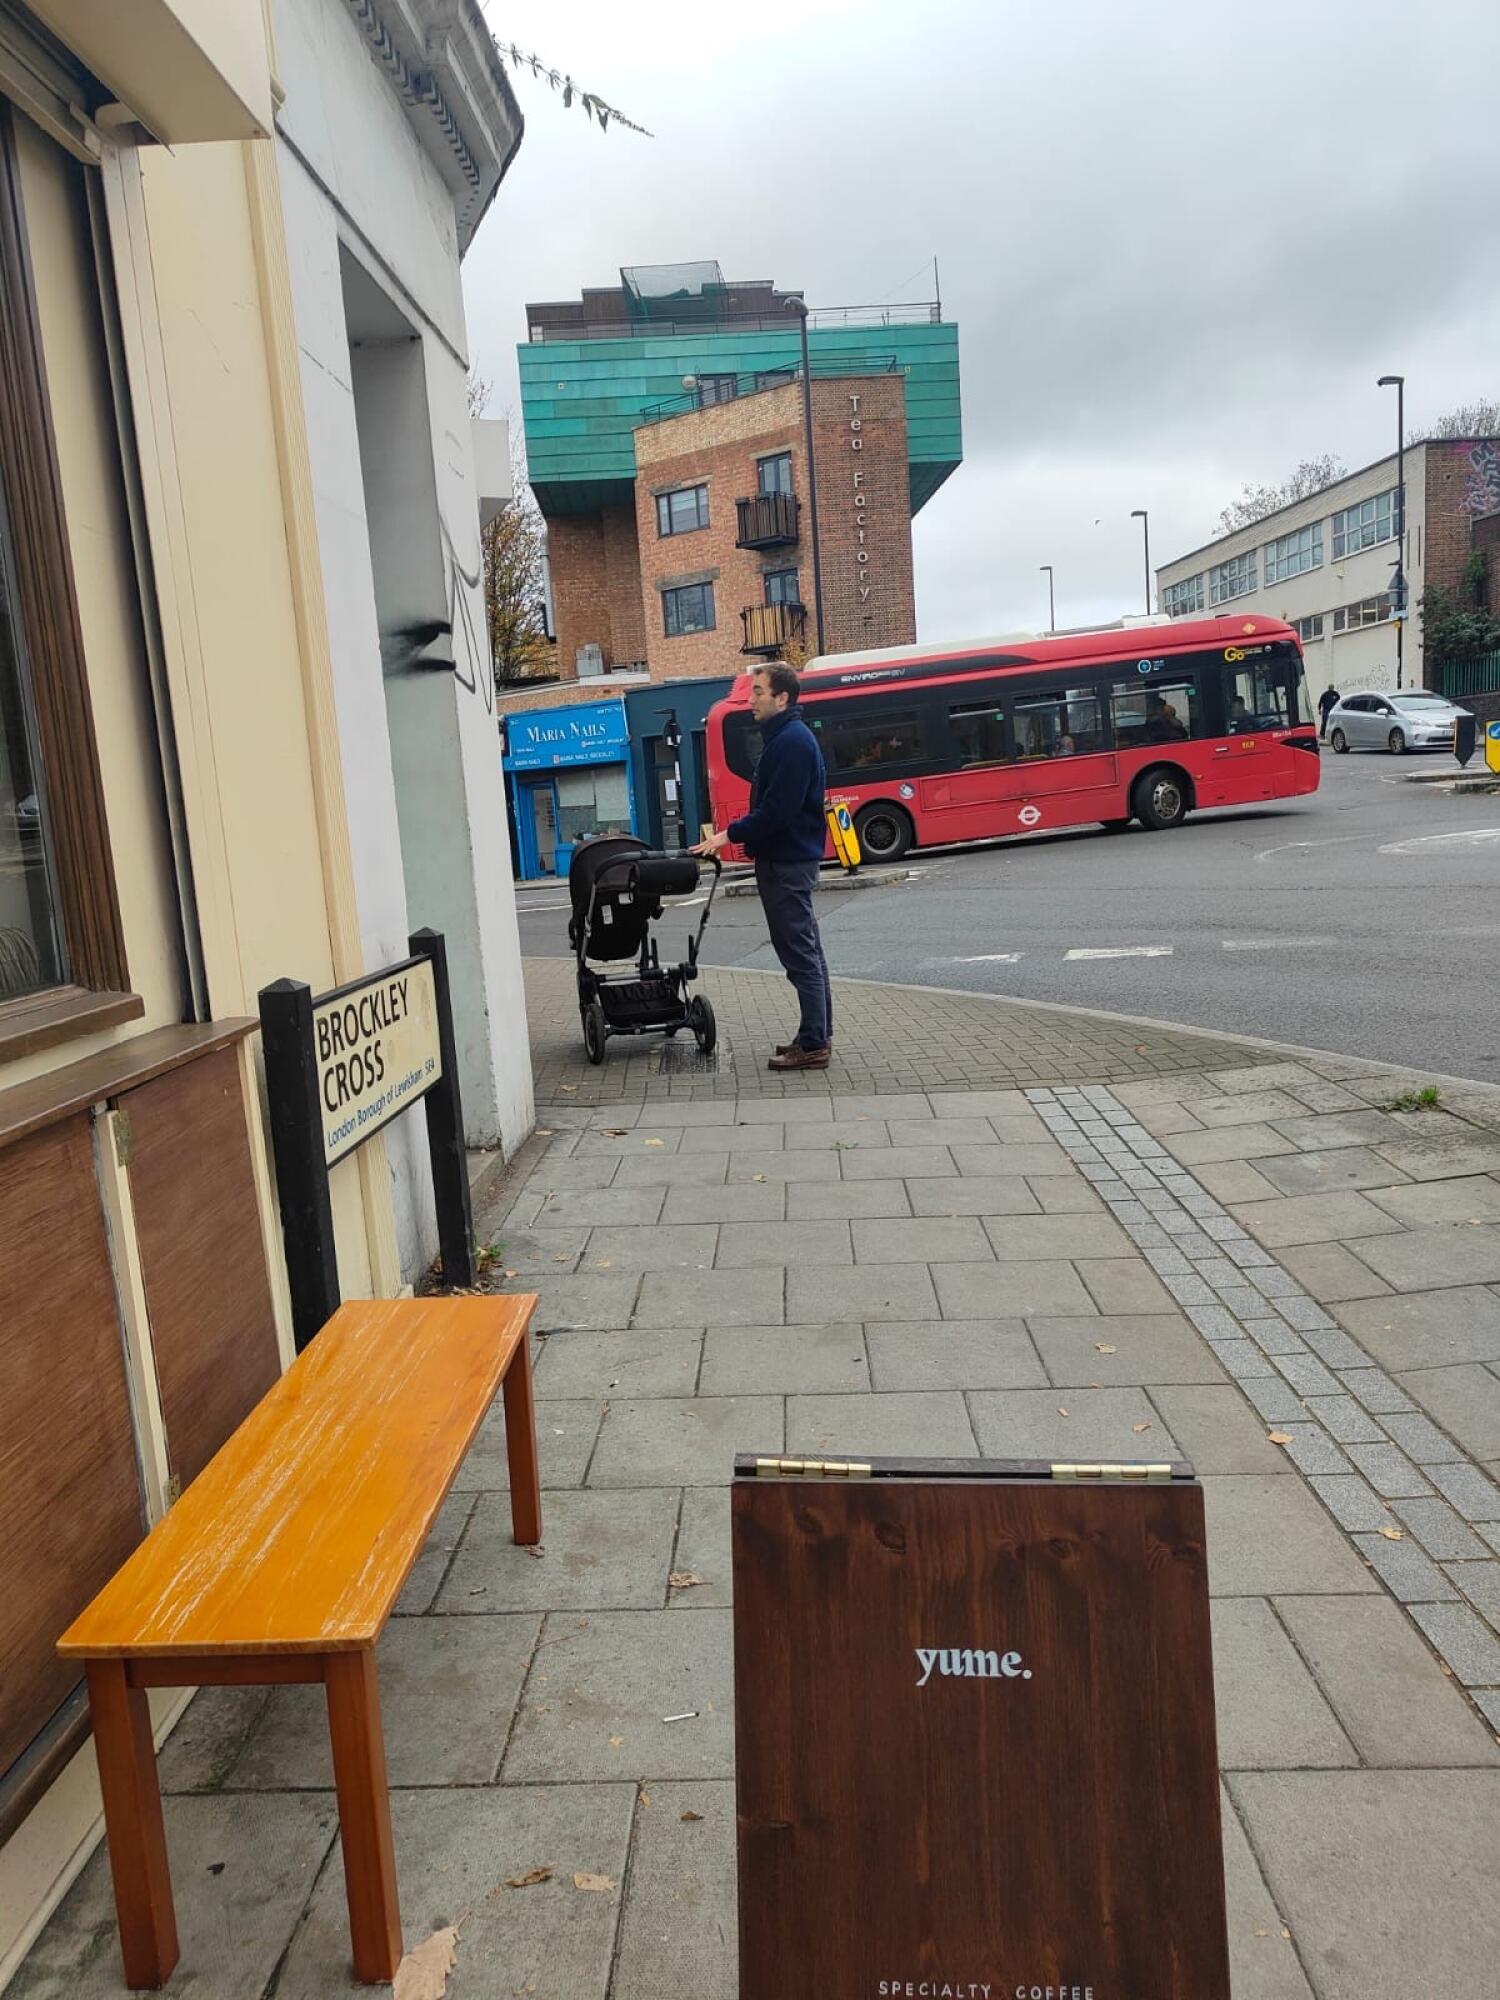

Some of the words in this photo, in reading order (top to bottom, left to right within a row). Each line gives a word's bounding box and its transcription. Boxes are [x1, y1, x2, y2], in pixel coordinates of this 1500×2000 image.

[850, 395, 862, 451] Tea
[853, 471, 870, 603] Factory
[316, 977, 409, 1062] BROCKLEY
[323, 1039, 385, 1112] CROSS
[328, 1117, 357, 1148] London
[358, 1095, 386, 1126] Borough
[387, 1085, 394, 1104] of
[394, 1069, 423, 1098] Lewisham
[915, 1647, 1033, 1687] yume.
[878, 1980, 992, 1999] SPECIALTY
[1015, 1985, 1094, 2000] COFFEE
